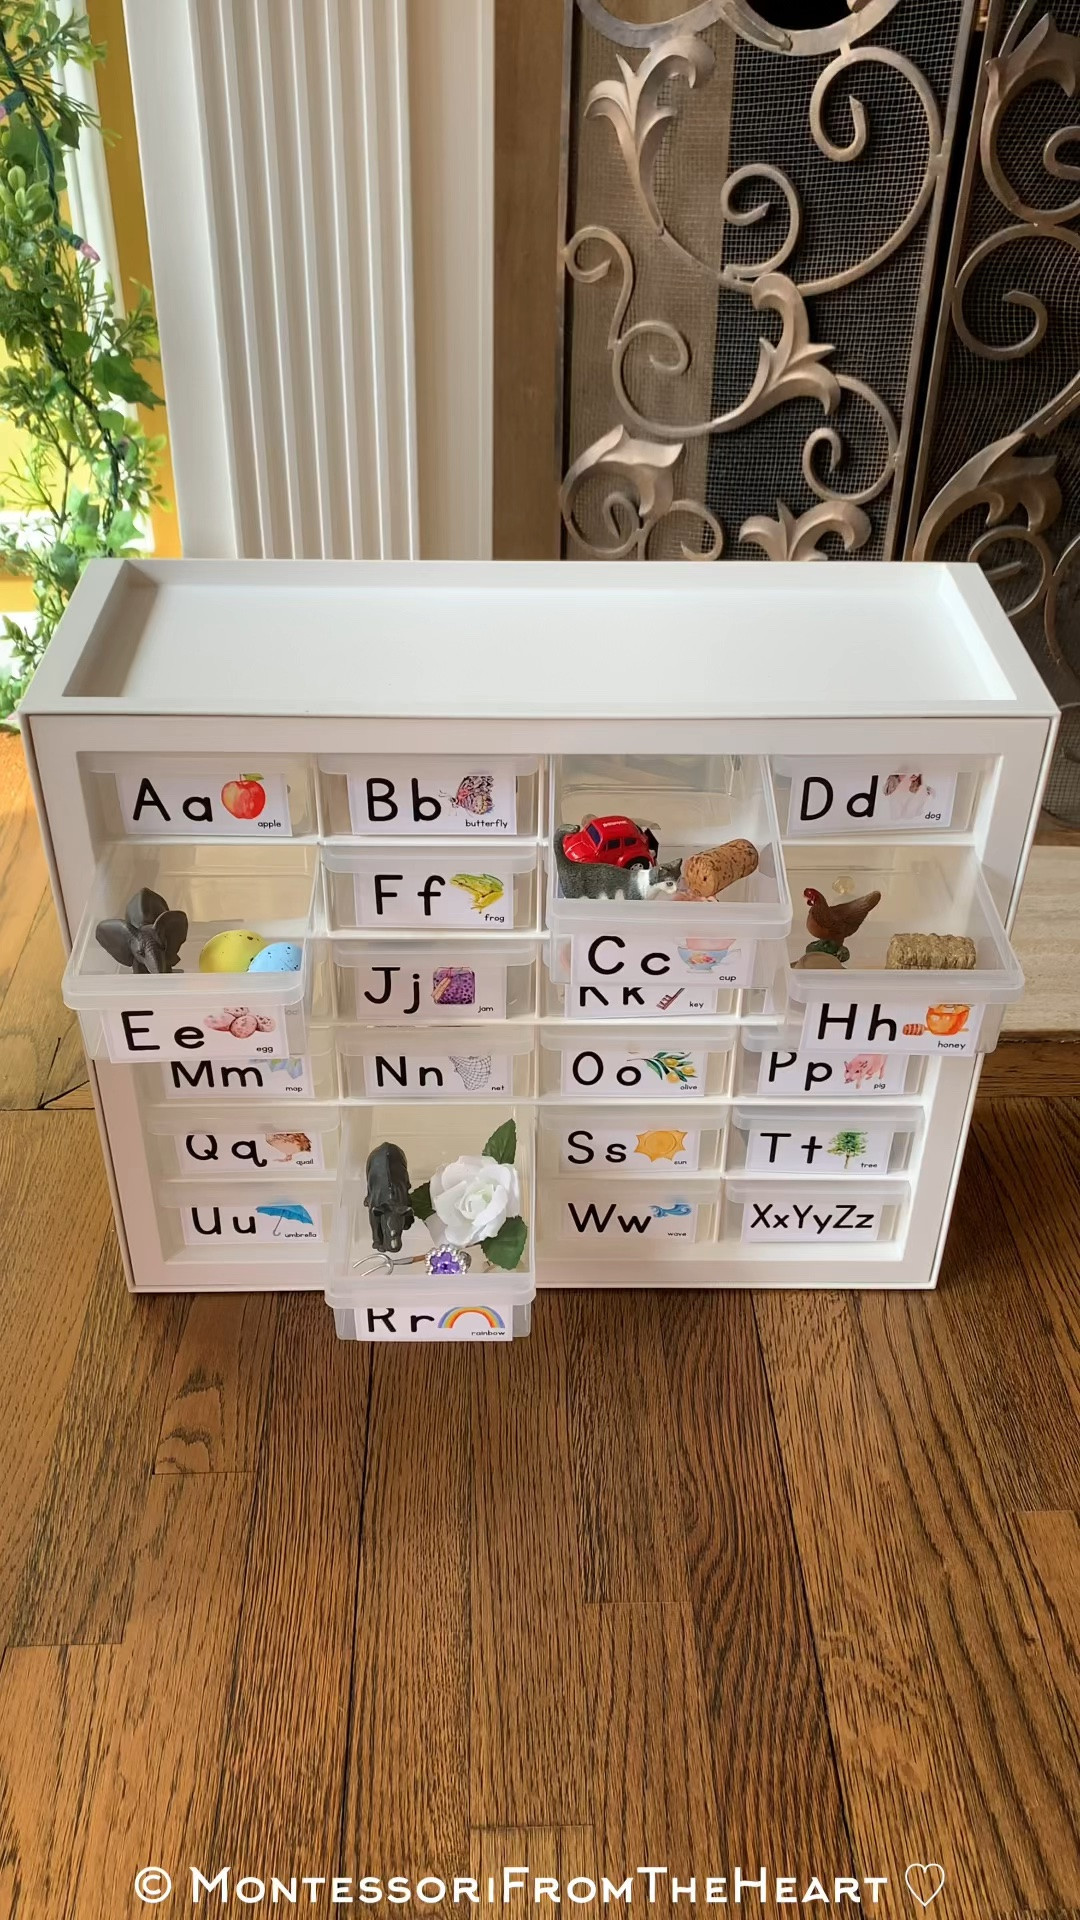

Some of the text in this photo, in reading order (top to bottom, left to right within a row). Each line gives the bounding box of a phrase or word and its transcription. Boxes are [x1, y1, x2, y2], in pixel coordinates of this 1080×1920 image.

[924, 811, 942, 821] dog
[256, 818, 282, 829] apple
[465, 818, 508, 829] butterfly
[484, 913, 505, 924] frog
[718, 975, 737, 983] cup
[689, 1000, 705, 1009] key
[477, 1005, 494, 1014] jam
[255, 1046, 274, 1054] egg
[937, 1040, 967, 1051] honey
[679, 1083, 698, 1091] olive
[873, 1082, 886, 1090] pig
